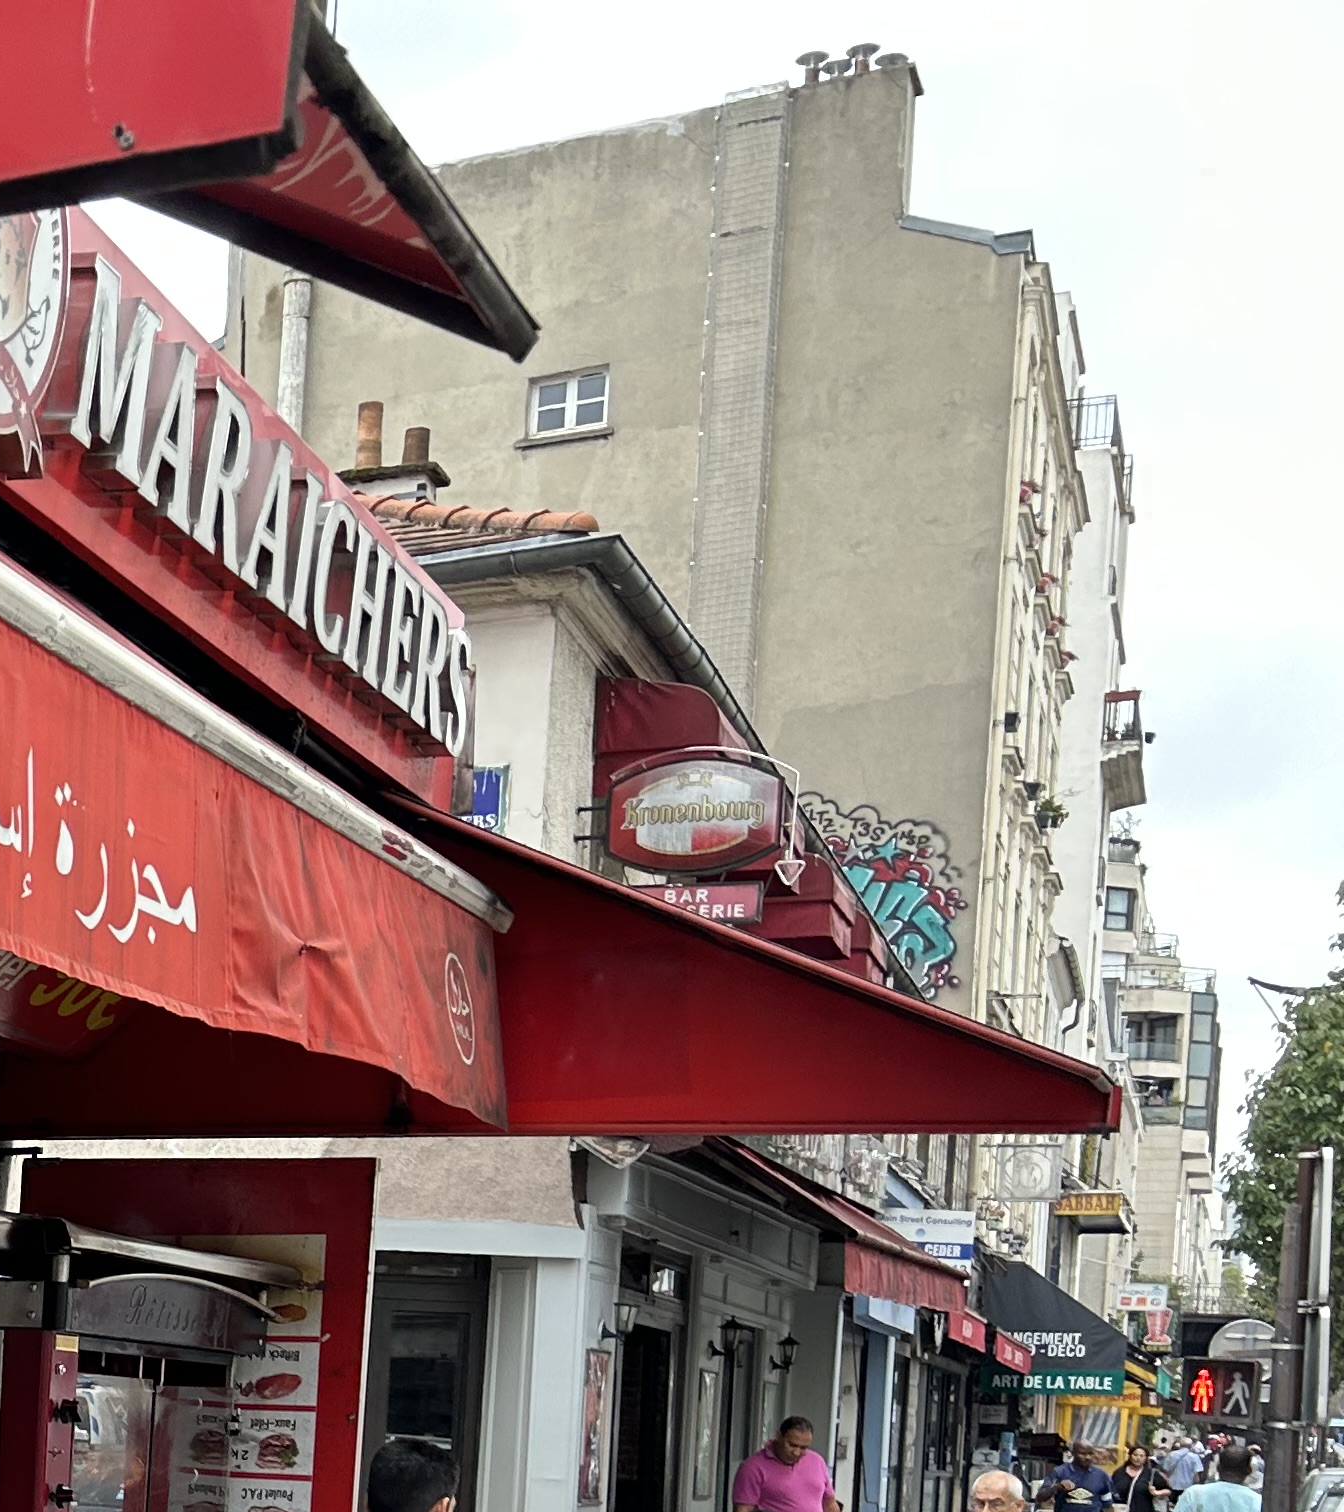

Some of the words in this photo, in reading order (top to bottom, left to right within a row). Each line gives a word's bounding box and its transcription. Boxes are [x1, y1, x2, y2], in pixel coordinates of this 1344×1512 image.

[72, 253, 472, 757] MARAICHERS
[621, 795, 766, 830] Kronenbourg
[54, 781, 198, 945] مجزرة
[664, 888, 710, 903] BAR
[924, 1243, 962, 1257] CEDER
[991, 1375, 1021, 1388] ART
[1023, 1375, 1042, 1389] DE
[1046, 1376, 1065, 1390] LA
[1067, 1376, 1113, 1391] TABLE
[266, 1487, 293, 1501] Poulet
